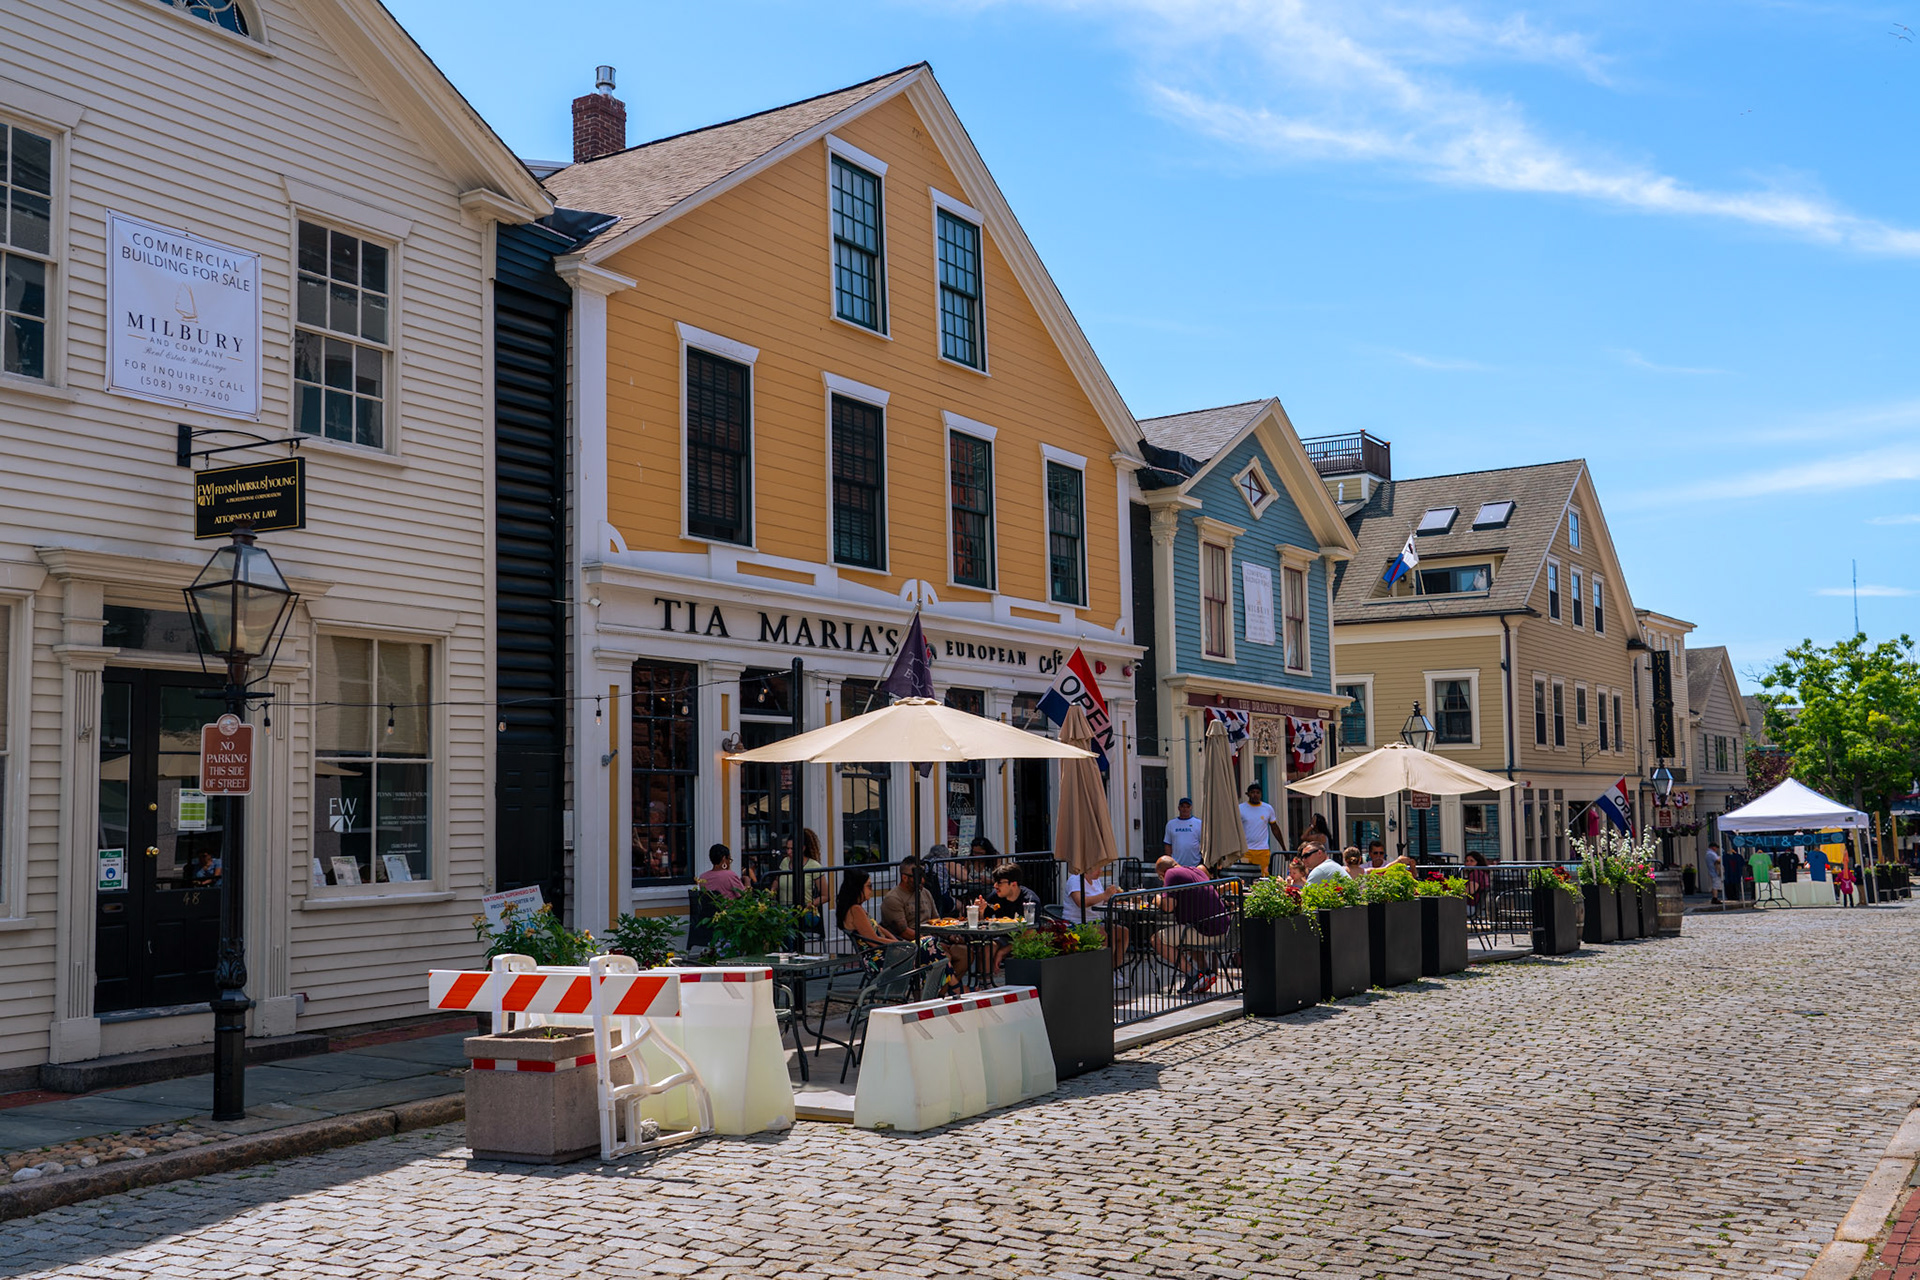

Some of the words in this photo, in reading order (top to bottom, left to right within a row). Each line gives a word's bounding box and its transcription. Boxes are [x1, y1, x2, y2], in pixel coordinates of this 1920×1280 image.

[132, 232, 240, 273] COMMERCIAL
[122, 246, 188, 275] BUILDING
[192, 266, 219, 282] FOR
[222, 274, 250, 292] SALE
[127, 311, 244, 352] MILBURY
[150, 336, 170, 347] AND
[175, 342, 224, 359] COMPANY
[143, 346, 163, 358] Real
[165, 352, 187, 362] Estate
[190, 356, 226, 374] Brokerage
[124, 359, 146, 371] FOR
[153, 365, 214, 385] INQUIRIES
[219, 380, 245, 392] CALL
[140, 376, 172, 390] (508)
[178, 384, 230, 402] 997-7400
[214, 512, 251, 524] ATTORNEYS
[252, 511, 260, 520] AT
[262, 510, 278, 518] LAW
[654, 597, 730, 638] TIA
[758, 612, 899, 656] MARIA'S
[946, 640, 1027, 666] EUROPEAN
[1039, 649, 1063, 675] Café
[1060, 675, 1116, 752] OPEN
[1238, 700, 1250, 710] THE
[1252, 701, 1278, 714] DRAWING
[1279, 704, 1295, 715] ROOM
[220, 741, 235, 751] NO
[1660, 713, 1672, 757] TAVERN
[206, 754, 248, 763] PARKING
[206, 778, 216, 788] OF
[217, 778, 247, 788] STREET
[209, 766, 226, 775] THIS
[228, 766, 245, 776] SIDE
[1745, 836, 1778, 847] SALT
[1781, 837, 1792, 847] &
[1793, 834, 1830, 846] SOLE
[183, 892, 200, 905] 48
[484, 894, 505, 902] NATIONAL
[505, 890, 529, 898] SUPERHERO
